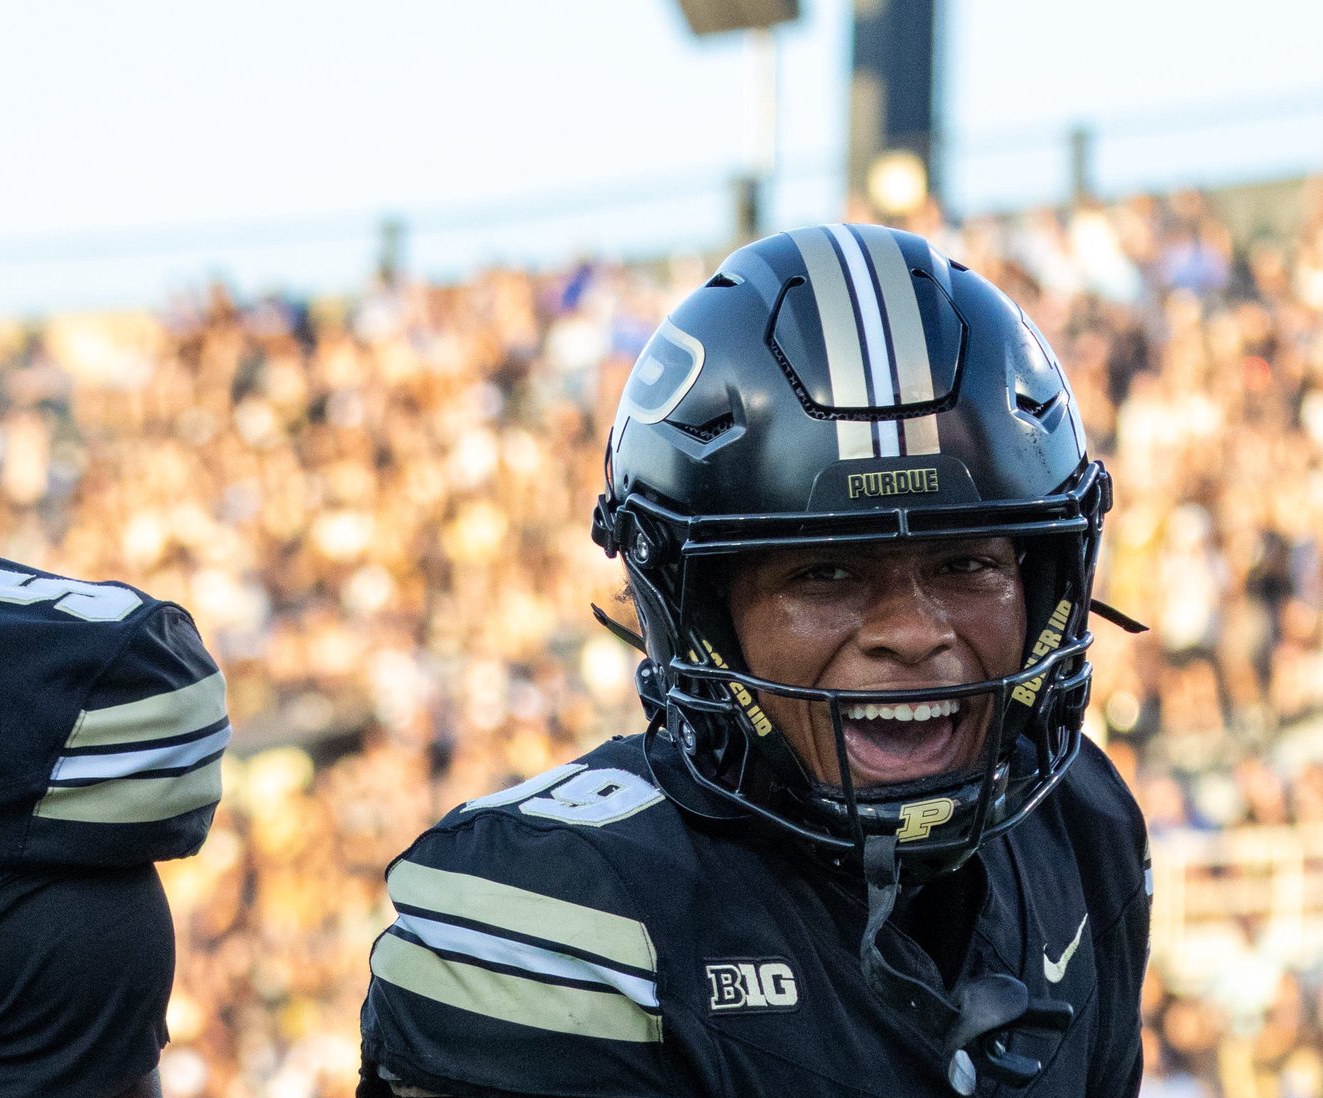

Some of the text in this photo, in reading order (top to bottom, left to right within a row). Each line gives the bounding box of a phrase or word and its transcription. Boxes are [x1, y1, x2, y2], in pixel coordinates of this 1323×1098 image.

[848, 468, 939, 499] PURDUE
[459, 763, 667, 828] 19
[896, 797, 955, 843] P
